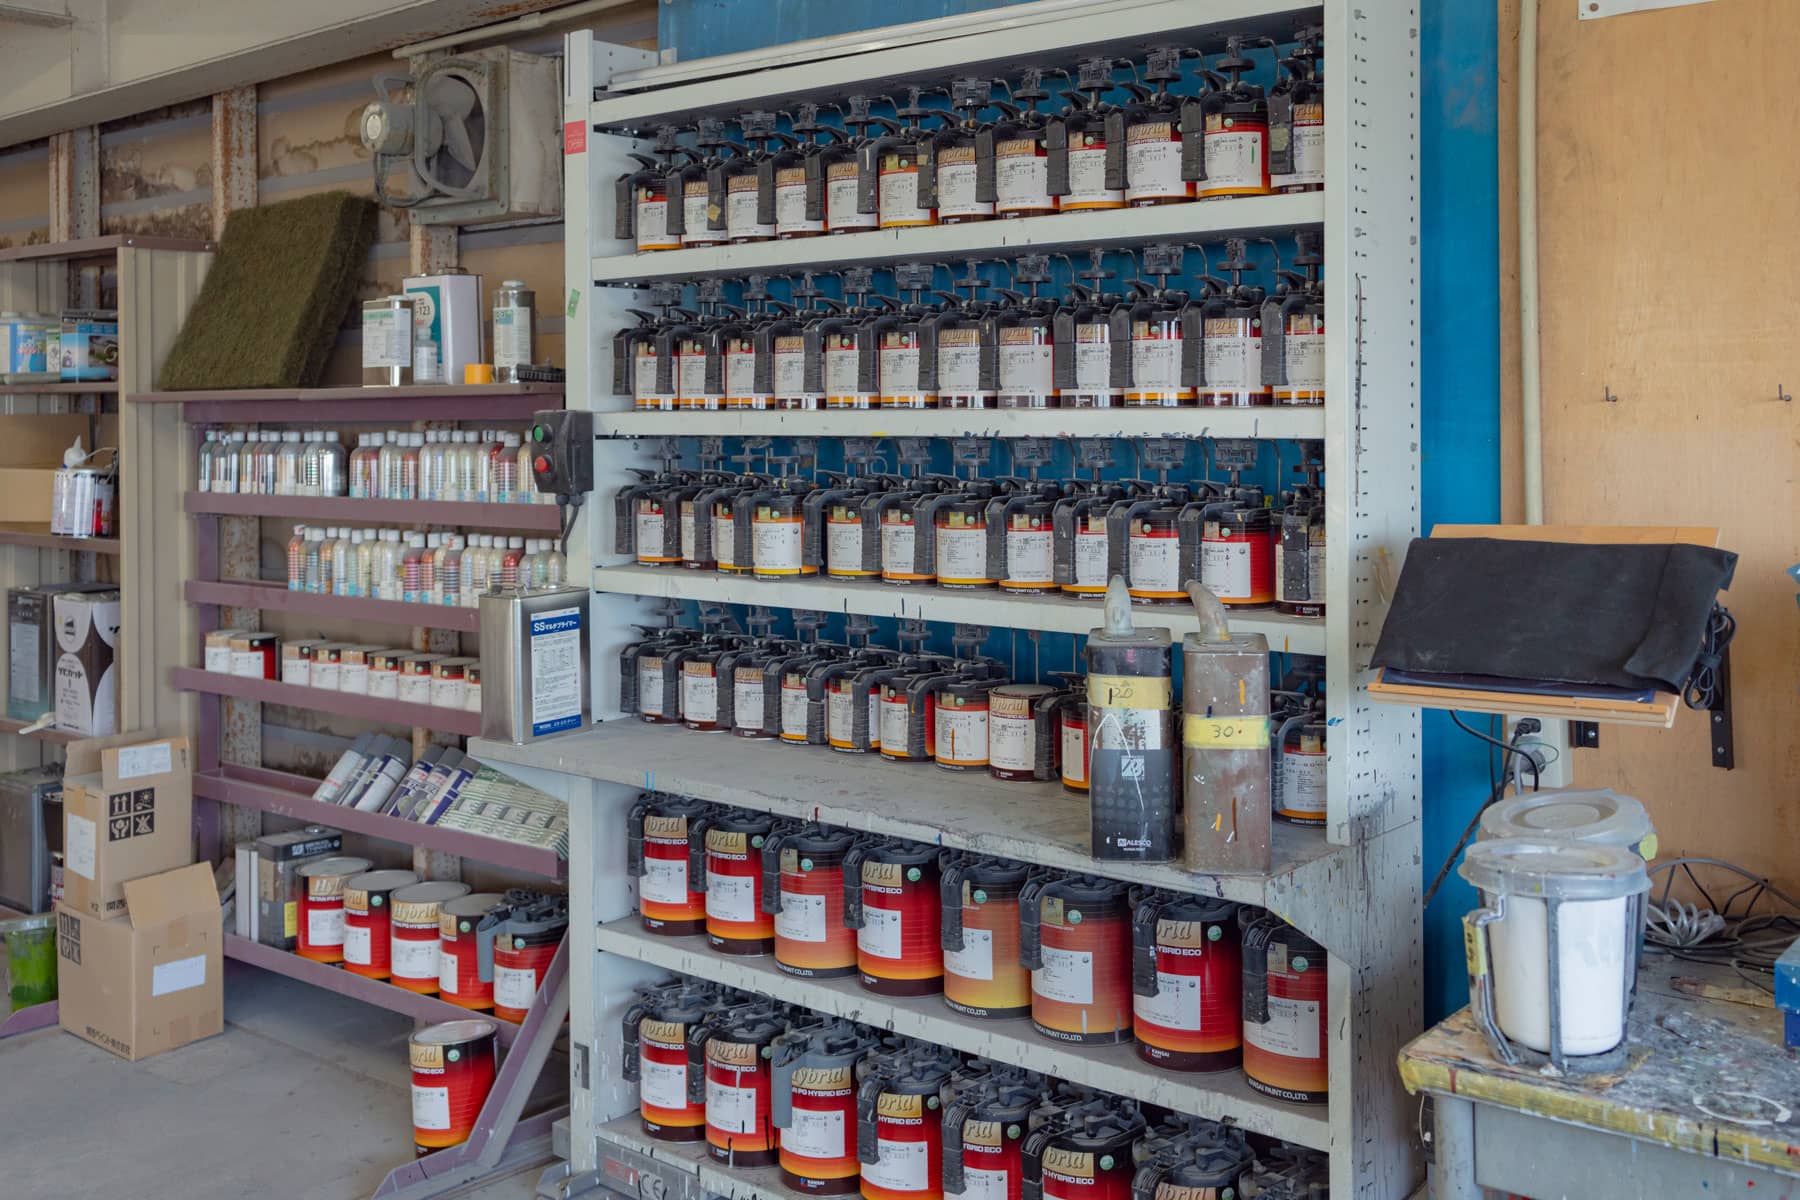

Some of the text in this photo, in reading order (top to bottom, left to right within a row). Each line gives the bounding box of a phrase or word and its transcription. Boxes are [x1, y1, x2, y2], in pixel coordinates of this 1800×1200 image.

[1213, 724, 1234, 738] 30
[1183, 949, 1202, 957] ECO
[807, 1088, 835, 1097] HYBRID
[835, 1088, 852, 1096] ECO
[905, 1117, 923, 1125] ECO
[984, 1146, 1002, 1154] ECO
[1048, 1171, 1076, 1184] HYBRID
[1076, 1177, 1095, 1185] ECO
